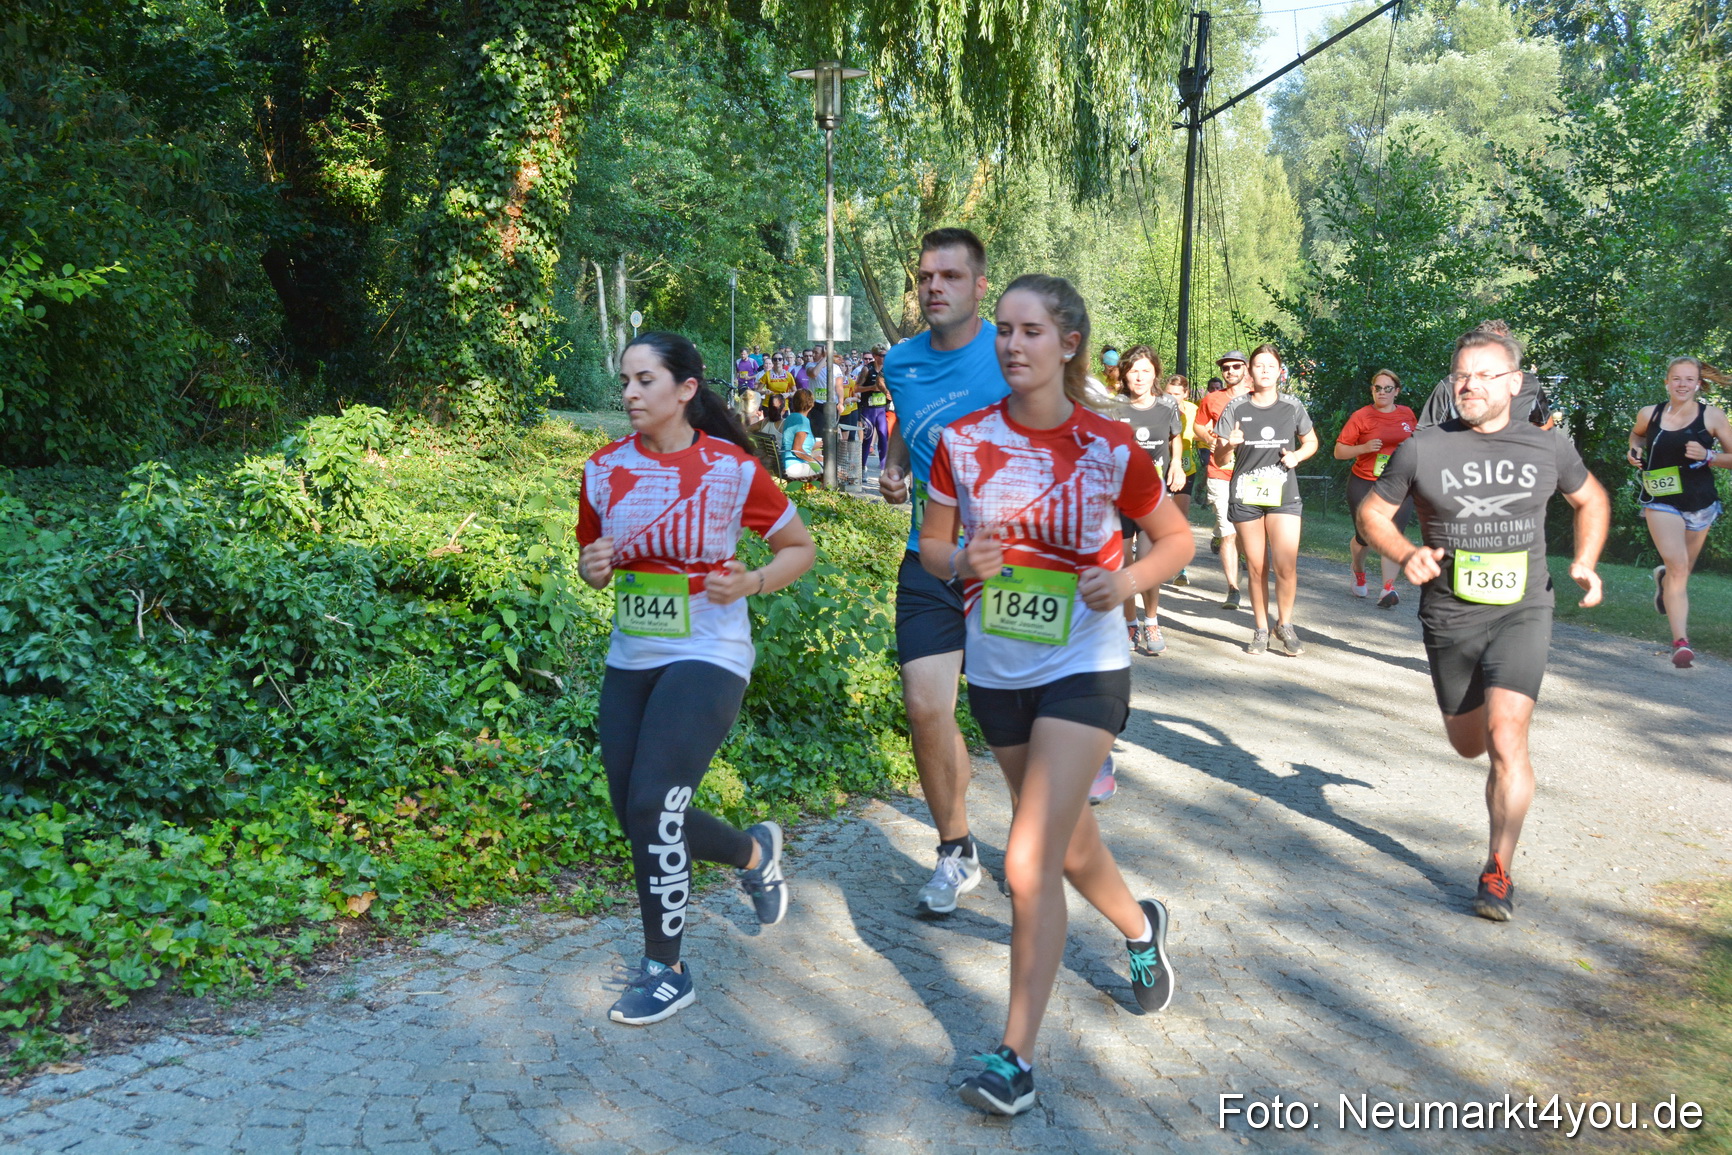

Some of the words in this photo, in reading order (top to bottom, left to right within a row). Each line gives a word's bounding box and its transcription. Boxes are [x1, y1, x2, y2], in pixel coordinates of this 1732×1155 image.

[902, 419, 917, 439] eam
[915, 397, 948, 419] Schick
[948, 389, 969, 401] Bau
[1441, 459, 1538, 495] ASICS
[1645, 476, 1675, 490] 1362
[1256, 487, 1270, 497] 74
[1443, 522, 1468, 535] THE
[1474, 518, 1537, 535] ORIGINAL
[1447, 535, 1503, 549] TRAINING
[1507, 532, 1535, 547] CLUB
[1463, 570, 1517, 589] 1363
[622, 594, 679, 620] 1844
[993, 590, 1059, 623] 1849
[648, 785, 693, 938] adidas
